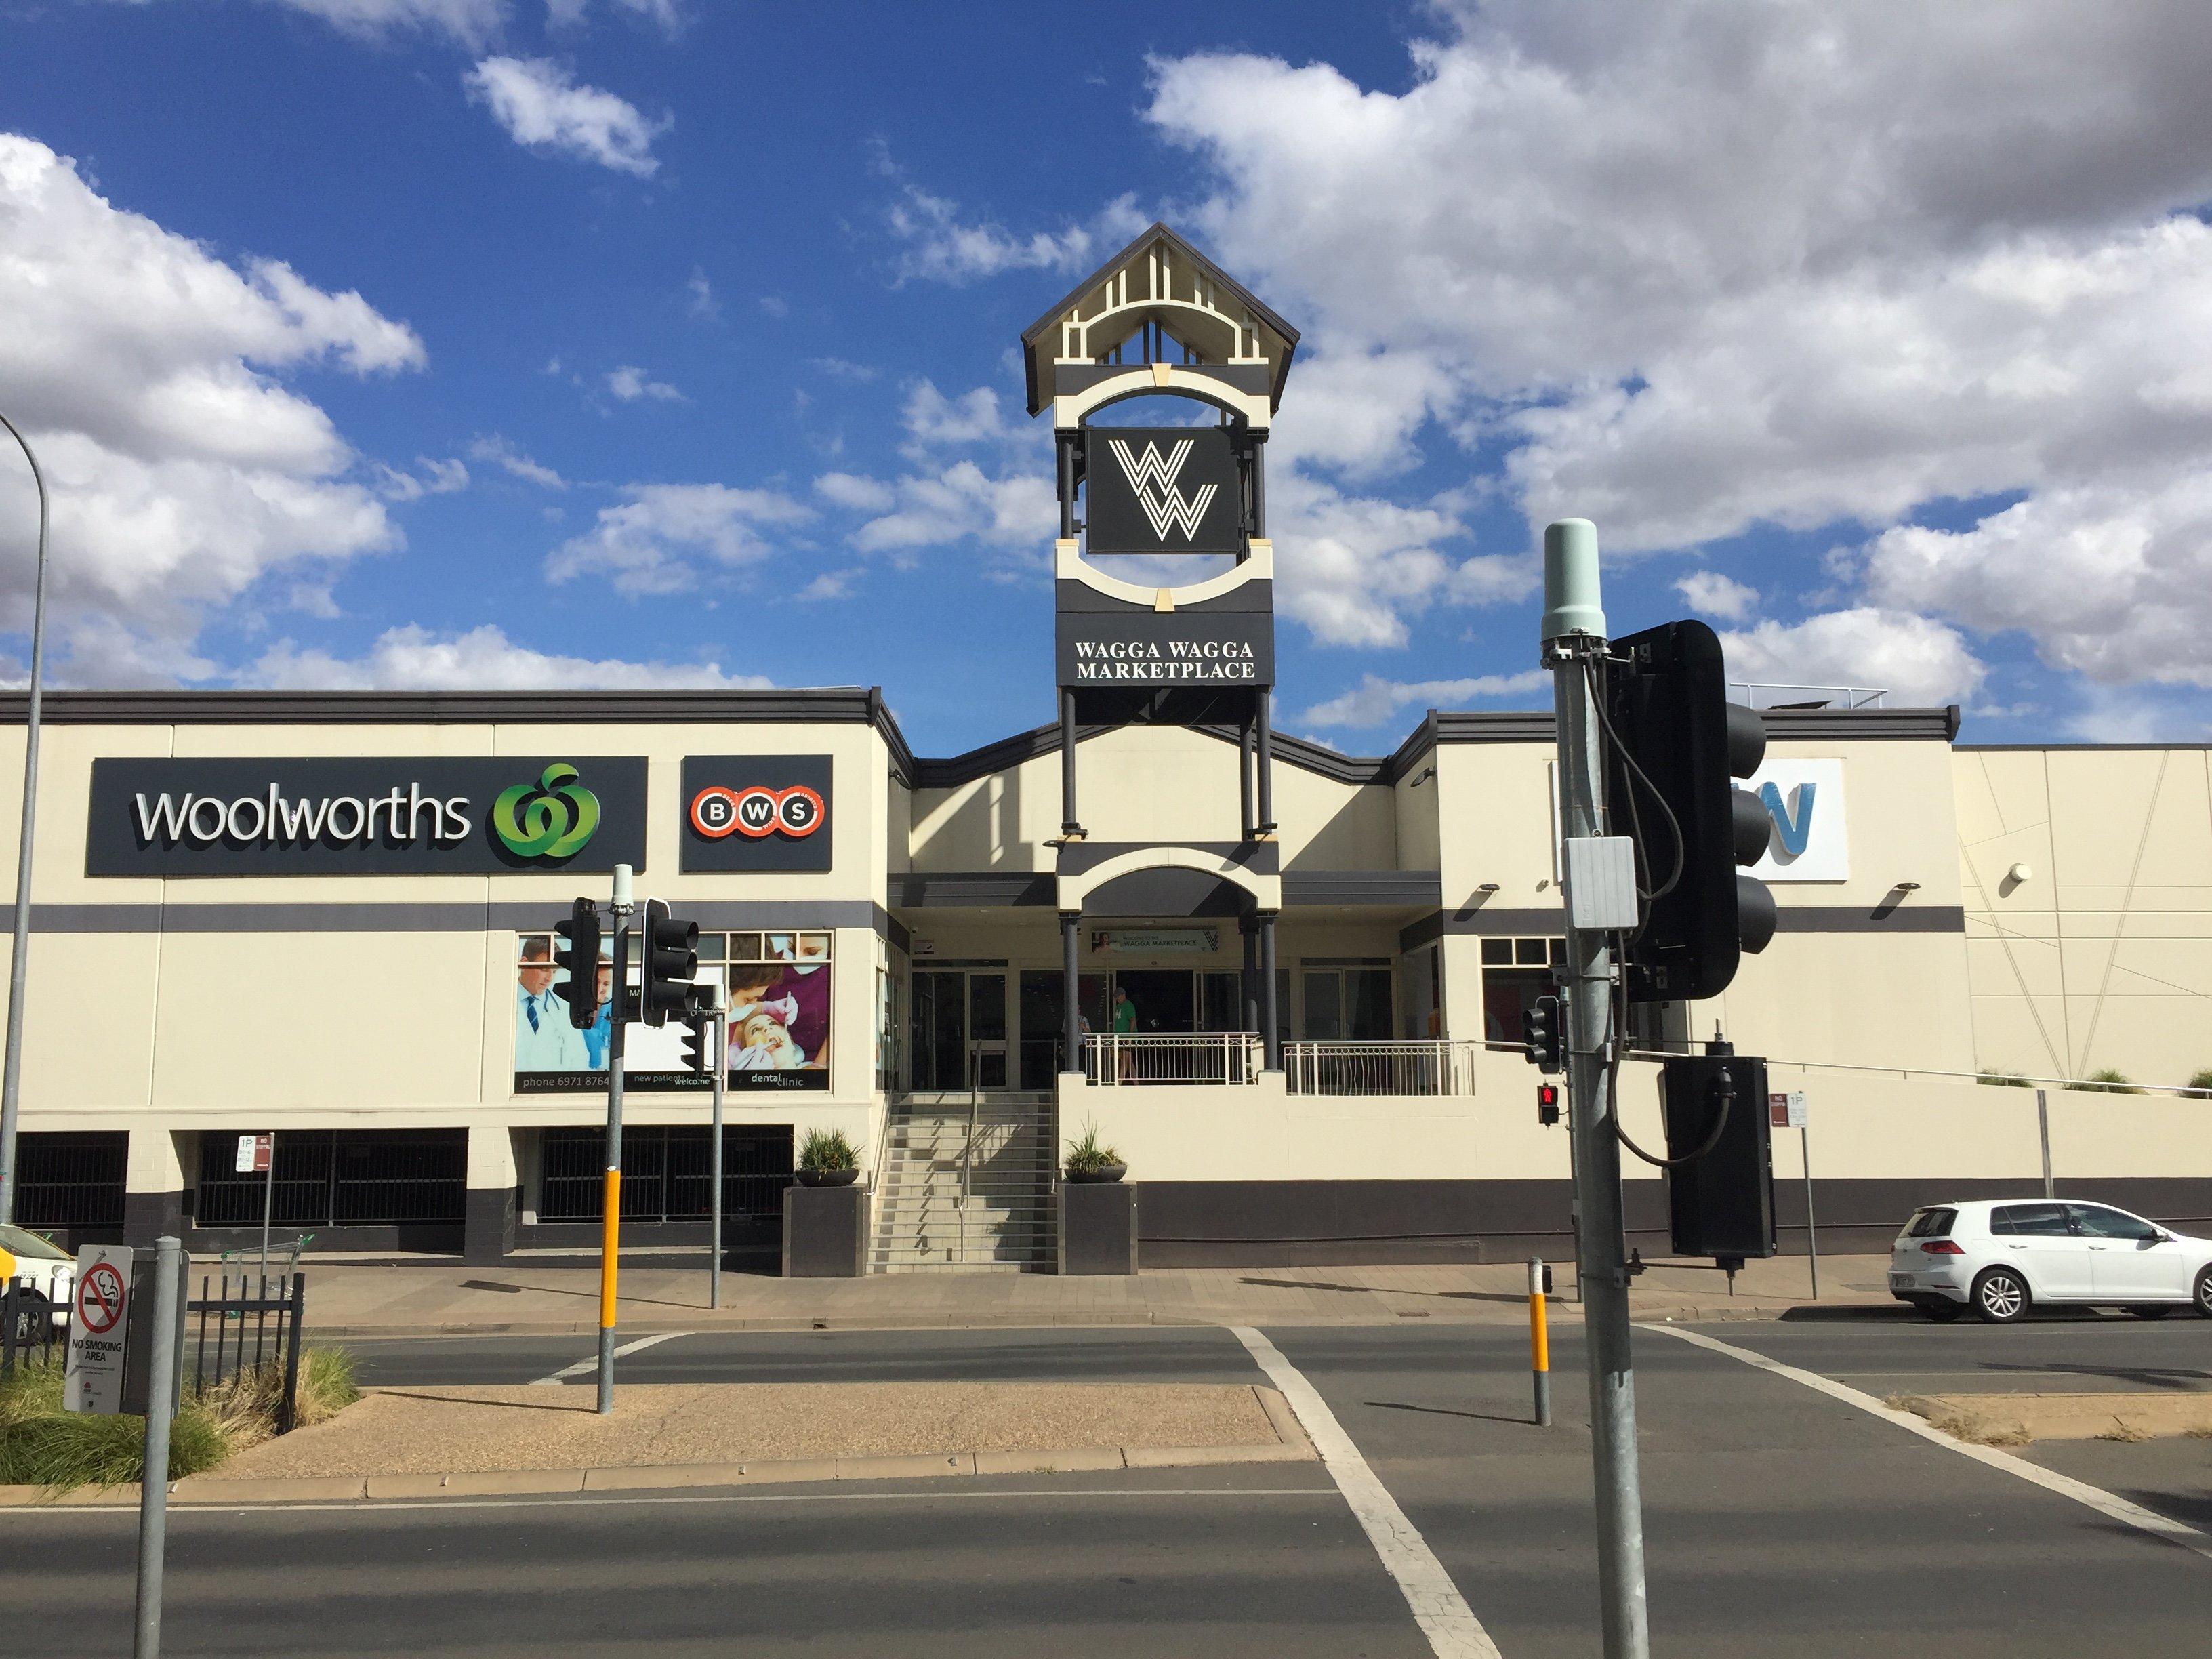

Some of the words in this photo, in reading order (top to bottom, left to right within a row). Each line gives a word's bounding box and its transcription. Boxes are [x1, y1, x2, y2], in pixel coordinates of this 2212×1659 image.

[1076, 642, 1160, 658] WAGGA
[1168, 642, 1254, 658] WAGGA
[1077, 663, 1254, 678] MARKETPLACE
[136, 781, 472, 840] Woolworths
[523, 1077, 555, 1088] phone
[558, 1076, 581, 1086] 6971
[585, 1076, 609, 1086] 8764
[653, 1073, 685, 1082] patients
[752, 1073, 781, 1082] dental
[777, 1078, 804, 1086] clinic
[1791, 1096, 1803, 1105] 1P
[241, 1139, 253, 1147] 1P
[72, 1339, 83, 1349] NO
[85, 1340, 121, 1352] SMOKING
[85, 1351, 106, 1361] AREA
